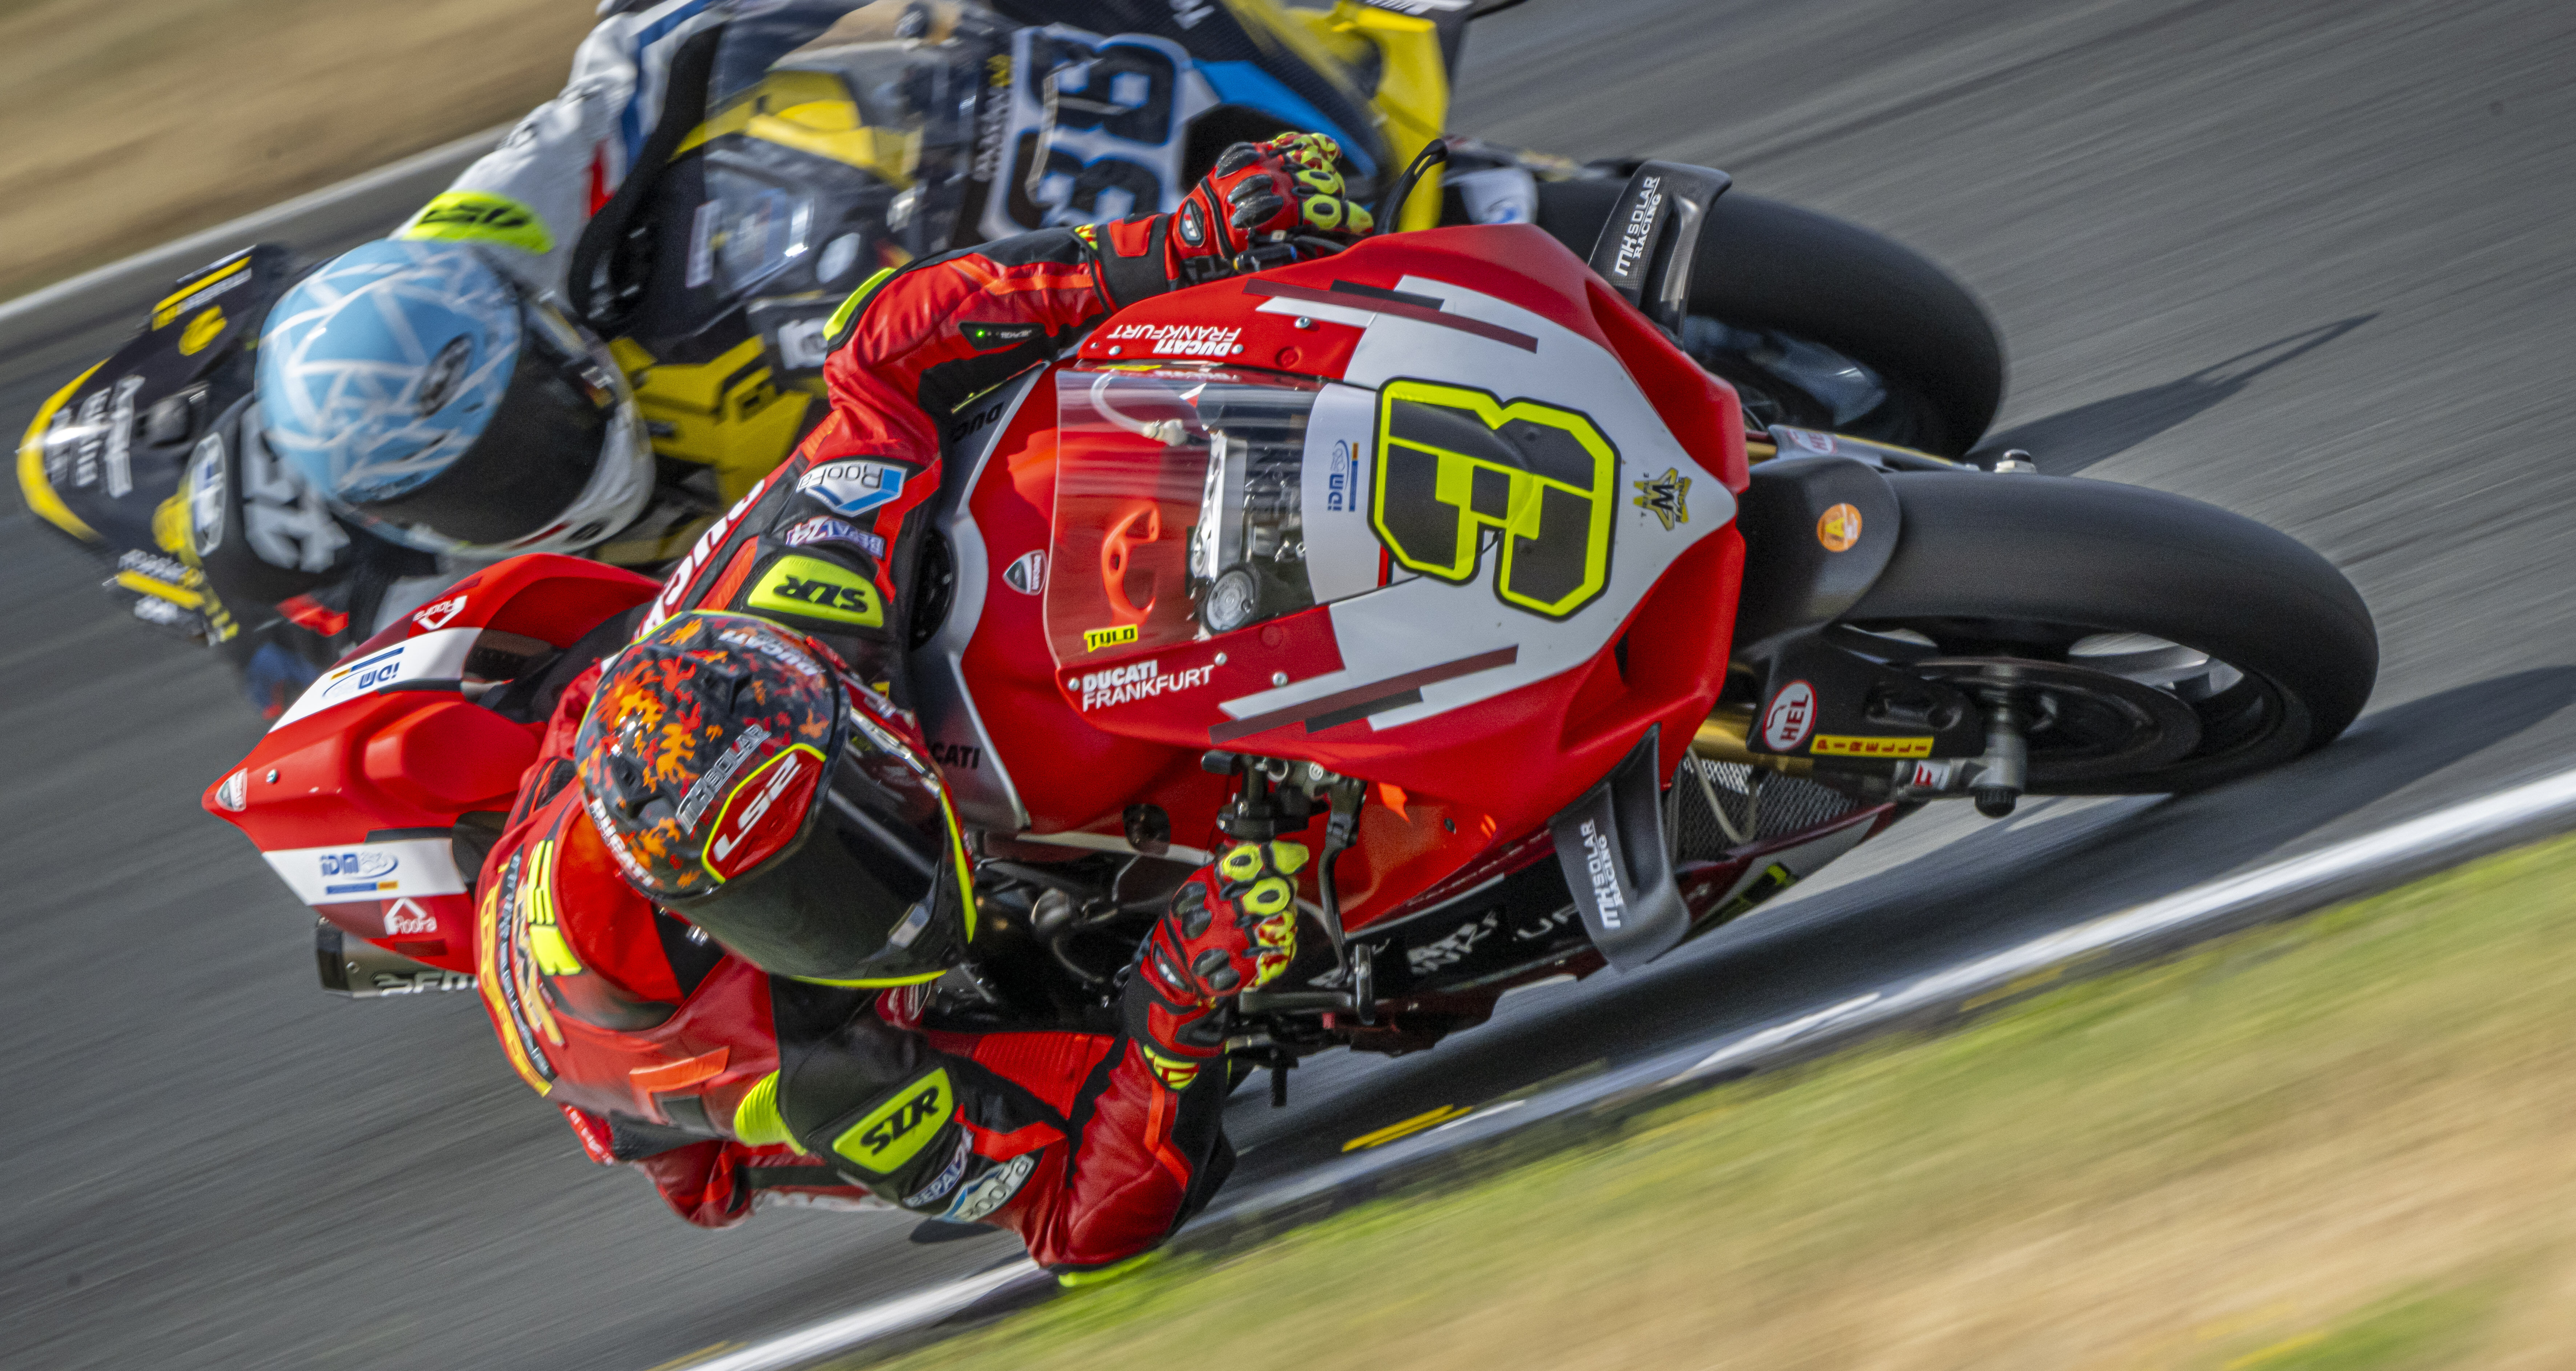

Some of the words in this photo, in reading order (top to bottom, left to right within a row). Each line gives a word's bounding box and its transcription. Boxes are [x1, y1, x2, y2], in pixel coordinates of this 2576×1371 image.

[1628, 176, 1660, 235] SOLAR
[1633, 193, 1662, 259] RACING
[1106, 324, 1241, 341] FRANKFURT
[1152, 339, 1233, 356] DUCATI
[952, 401, 1004, 443] DUC
[773, 575, 868, 613] SLR
[718, 630, 818, 676] DUCATI
[1083, 659, 1157, 692] DUCATI
[1083, 664, 1215, 712] FRANKFURT
[1780, 693, 1809, 740] HEL
[705, 724, 771, 791] SOLAR
[932, 742, 981, 770] CATI
[1817, 739, 1927, 752] PIRELLI
[713, 752, 802, 863] LS2
[1580, 819, 1604, 884] SOLAR
[1600, 834, 1624, 906] RACING
[859, 1085, 939, 1156] SLR
